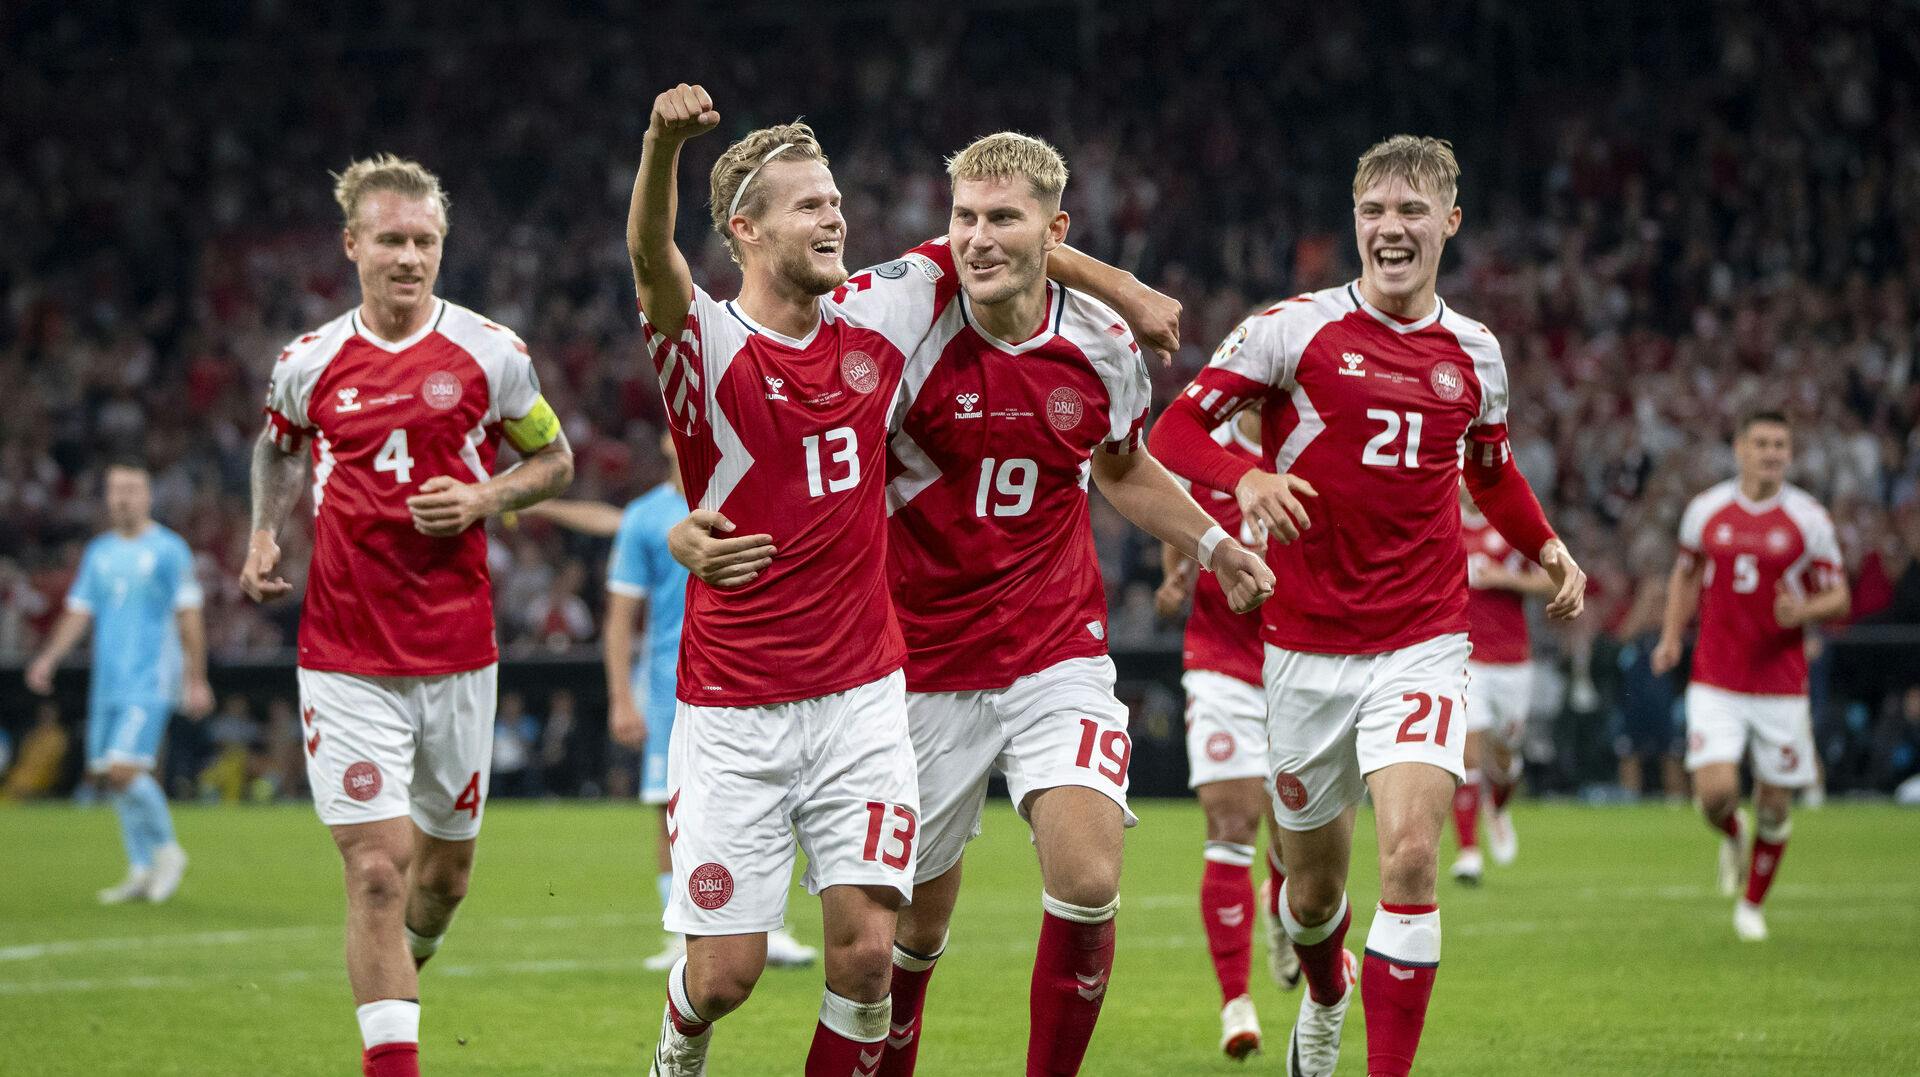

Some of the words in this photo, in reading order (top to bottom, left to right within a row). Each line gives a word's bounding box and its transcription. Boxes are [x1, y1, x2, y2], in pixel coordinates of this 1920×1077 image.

[849, 362, 870, 380] DBU
[1438, 373, 1456, 388] DBU
[955, 410, 983, 419] hummel
[1054, 401, 1075, 414] DBU
[373, 428, 415, 484] 4
[802, 426, 861, 498] 13
[1361, 408, 1423, 469] 21
[975, 457, 1039, 518] 19
[1395, 691, 1454, 748] 21
[1075, 718, 1132, 788] 19
[454, 770, 481, 821] 4
[862, 801, 917, 872] 13
[698, 878, 724, 892] DBU
